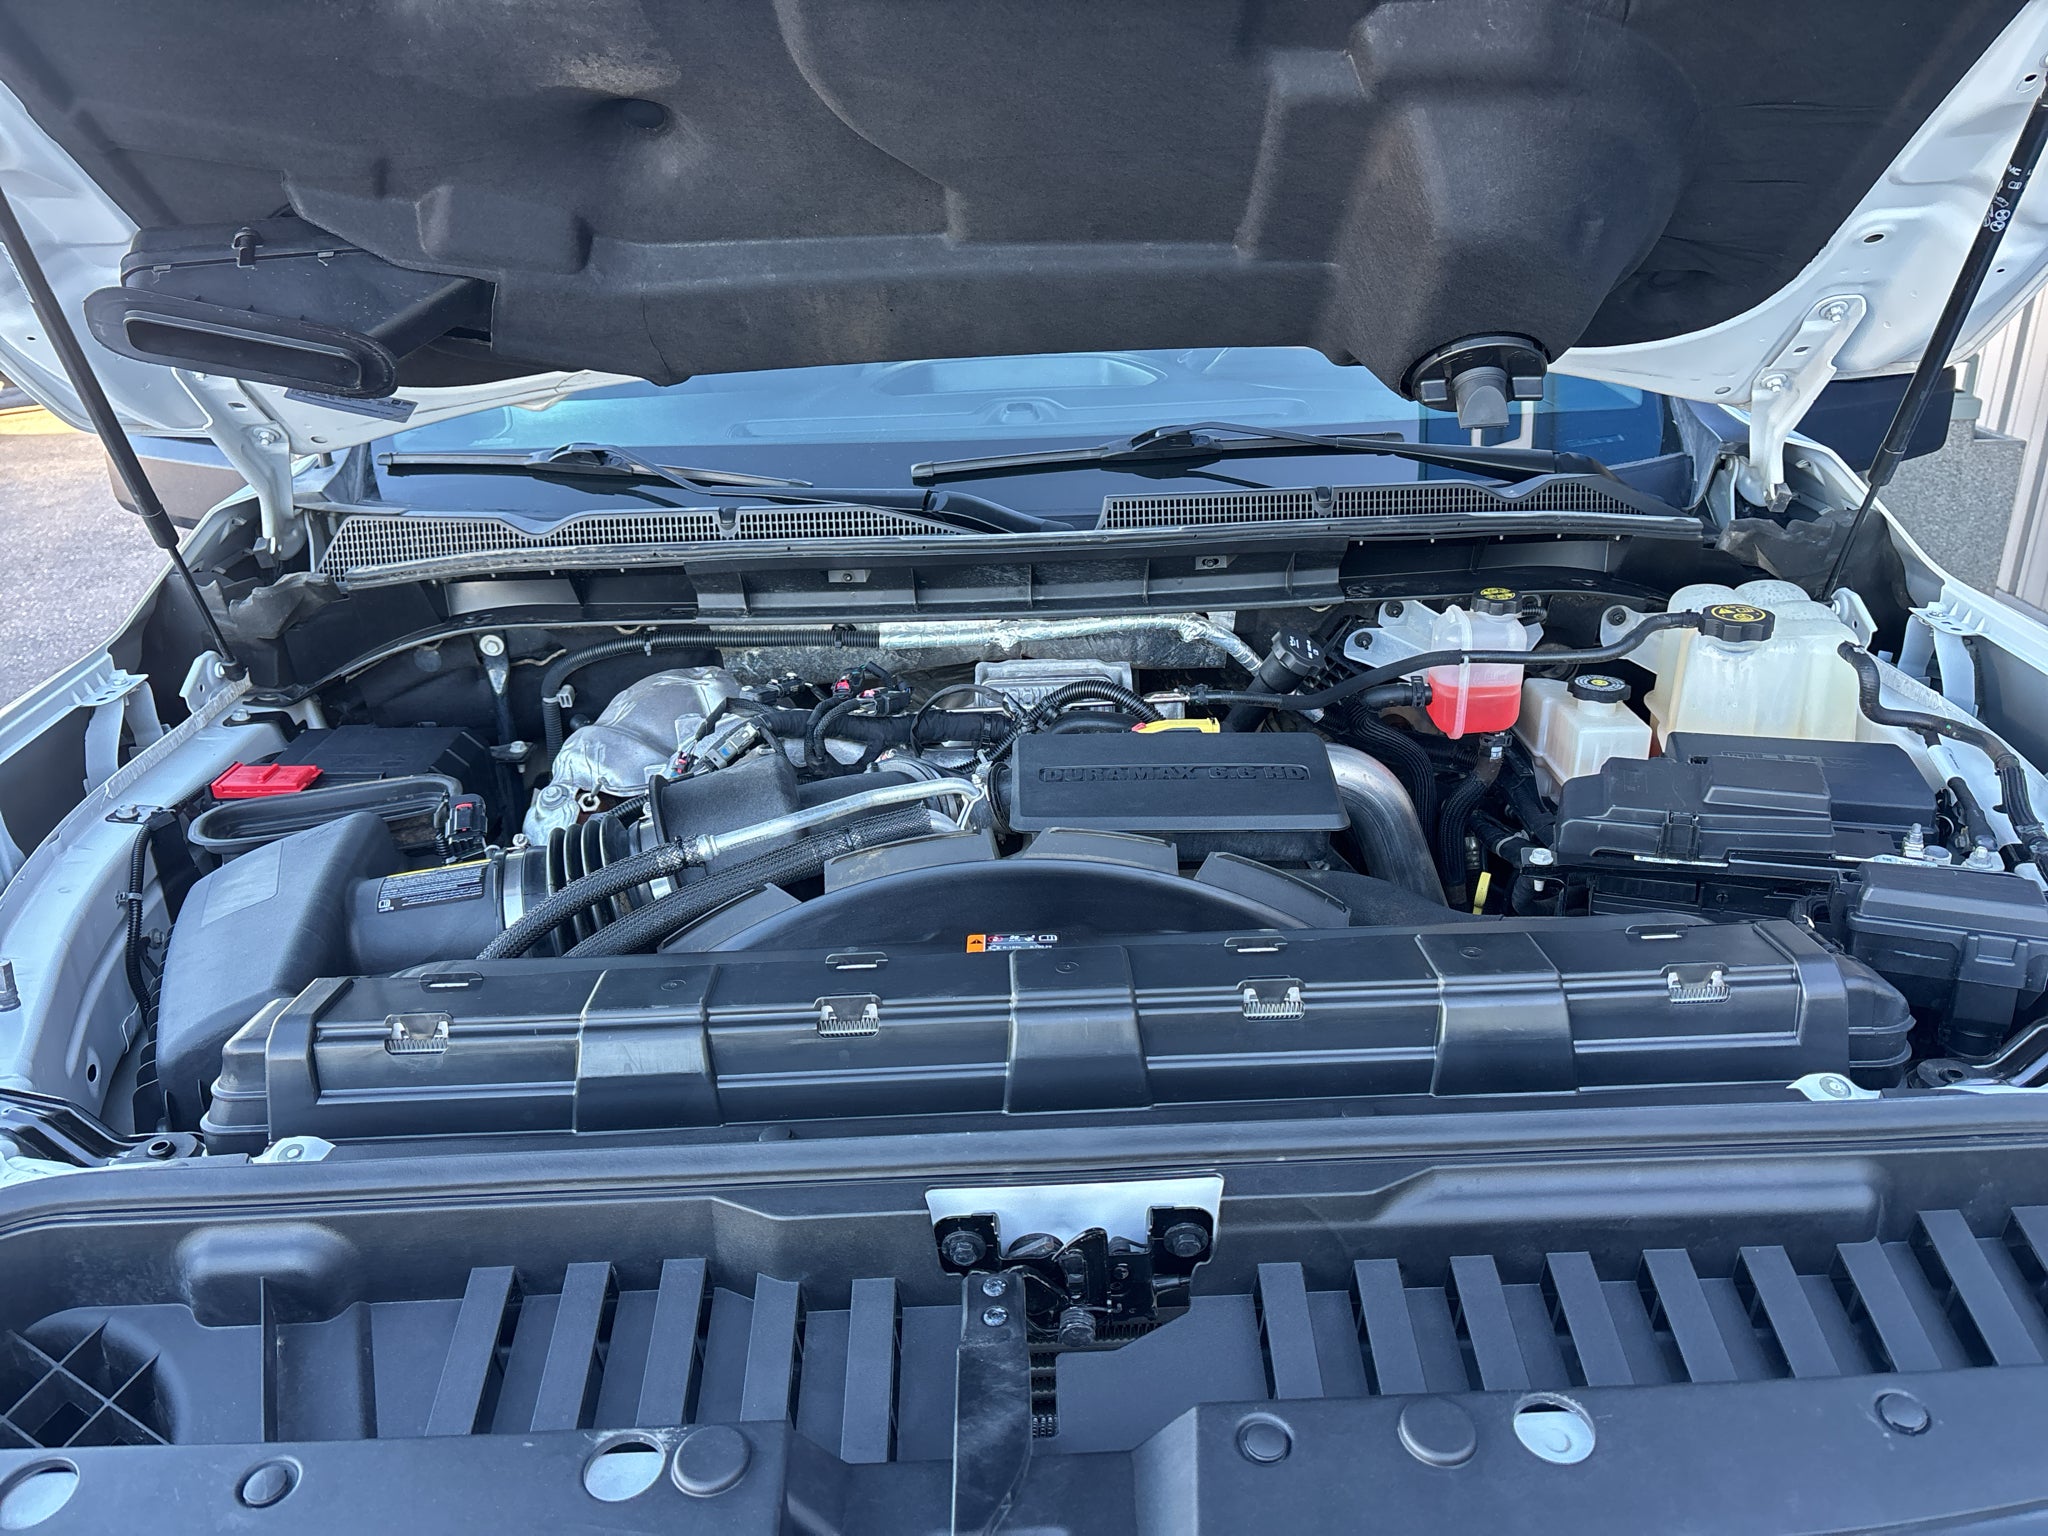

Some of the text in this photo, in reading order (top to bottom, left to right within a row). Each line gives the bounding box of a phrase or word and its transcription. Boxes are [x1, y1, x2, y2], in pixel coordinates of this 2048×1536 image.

[1040, 766, 1307, 782] DURAMAX 6.6 HD
